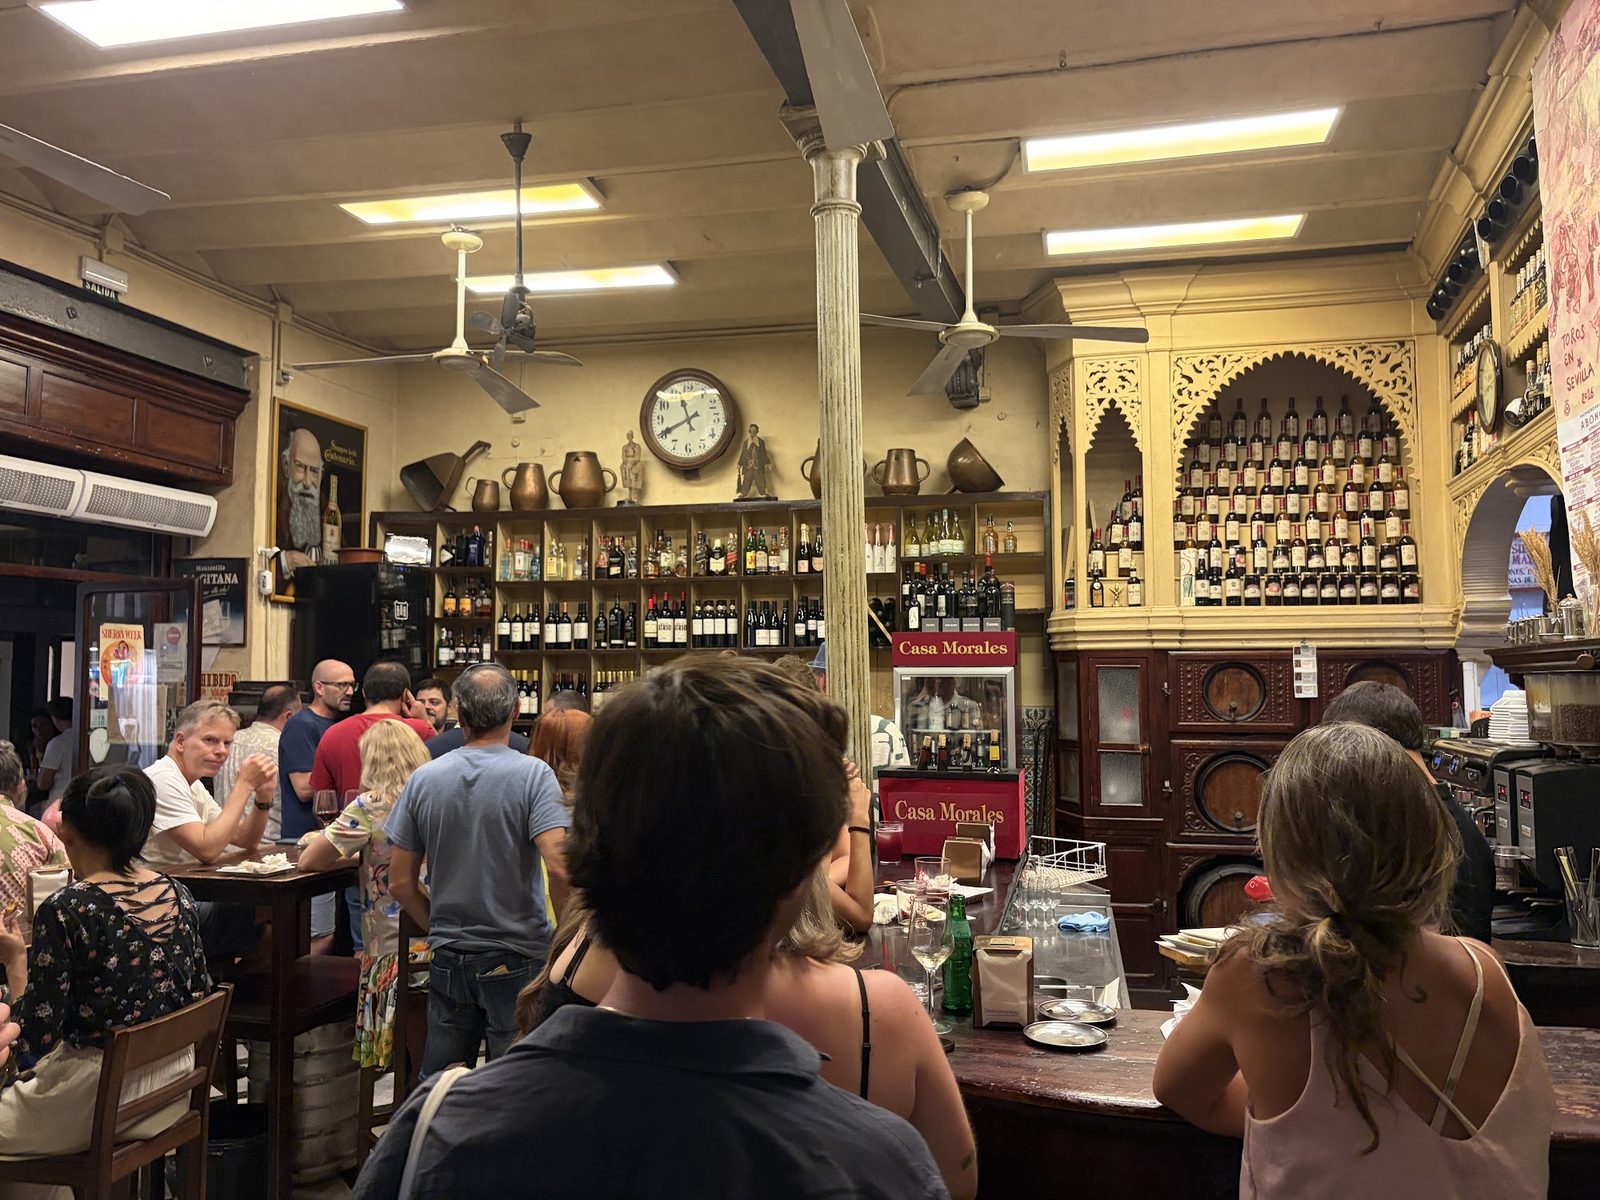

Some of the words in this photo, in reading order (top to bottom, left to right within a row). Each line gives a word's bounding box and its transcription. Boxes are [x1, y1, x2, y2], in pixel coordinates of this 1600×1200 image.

[85, 281, 116, 300] SALIDA
[1561, 323, 1586, 349] TOROS
[1564, 349, 1575, 367] EN
[1566, 362, 1595, 392] SEVILLA
[659, 400, 670, 411] 10
[656, 415, 664, 425] 9
[708, 428, 717, 439] 4
[671, 439, 679, 450] 7
[684, 443, 692, 454] 6
[698, 438, 706, 450] 5
[195, 564, 226, 572] Manzanilla
[200, 573, 239, 585] GITANA
[101, 629, 125, 639] SHERRY
[125, 630, 142, 640] WEEK
[899, 640, 939, 655] Casa
[942, 640, 1008, 655] Morales
[201, 673, 237, 687] HIBIDO
[894, 800, 936, 821] Casa
[939, 802, 1004, 824] Morales
